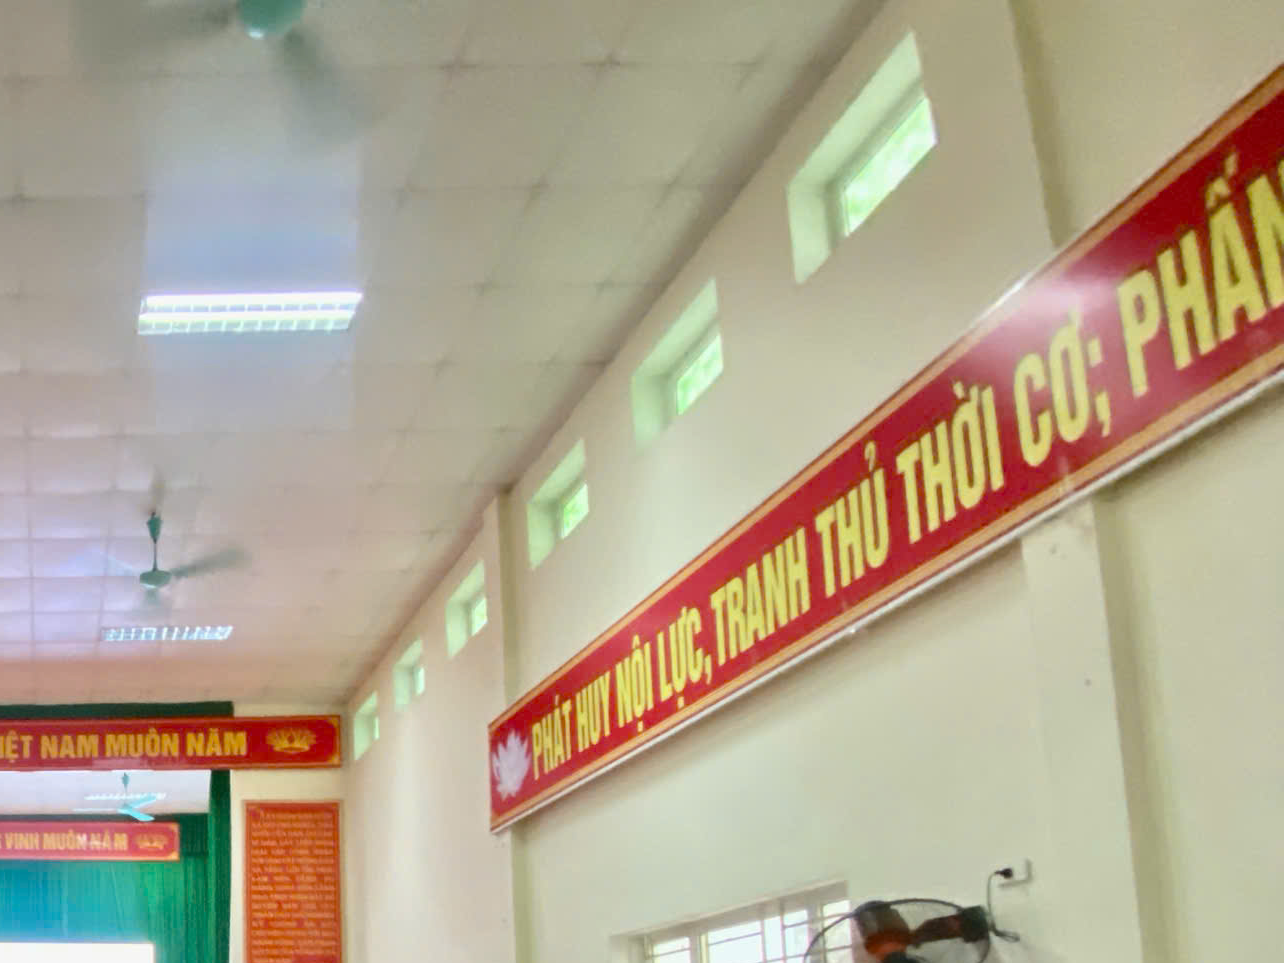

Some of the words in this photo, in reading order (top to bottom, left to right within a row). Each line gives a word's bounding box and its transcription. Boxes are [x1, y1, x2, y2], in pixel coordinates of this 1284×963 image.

[531, 694, 572, 780] PHÁT
[575, 671, 611, 753] HUY
[616, 634, 654, 733] NỘI
[656, 606, 712, 709] LỰC,
[710, 526, 811, 667] TRANH
[815, 440, 890, 599] THỦ
[895, 380, 1005, 545] THỜI
[1014, 307, 1112, 468] CƠ;
[40, 732, 99, 759] NAM
[105, 727, 180, 758] MUÔN
[185, 727, 248, 756] NĂM
[5, 832, 40, 850] VINH
